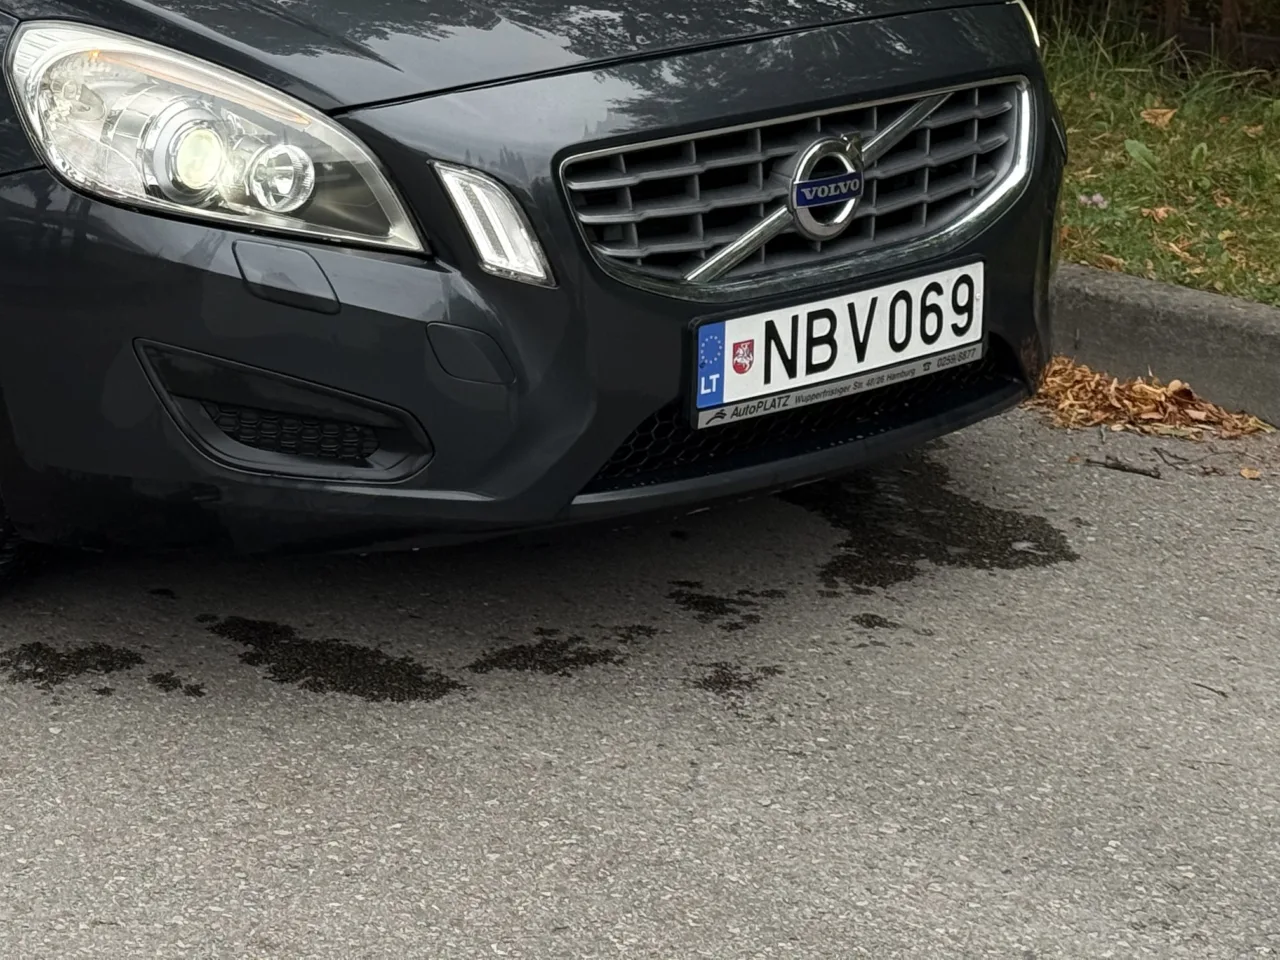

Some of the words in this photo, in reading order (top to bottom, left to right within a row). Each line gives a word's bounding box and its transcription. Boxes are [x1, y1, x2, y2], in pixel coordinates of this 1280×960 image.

[801, 179, 859, 200] VOLVO
[764, 274, 974, 385] NBV069
[701, 374, 720, 394] LT
[730, 395, 791, 419] AutoPLATZ
